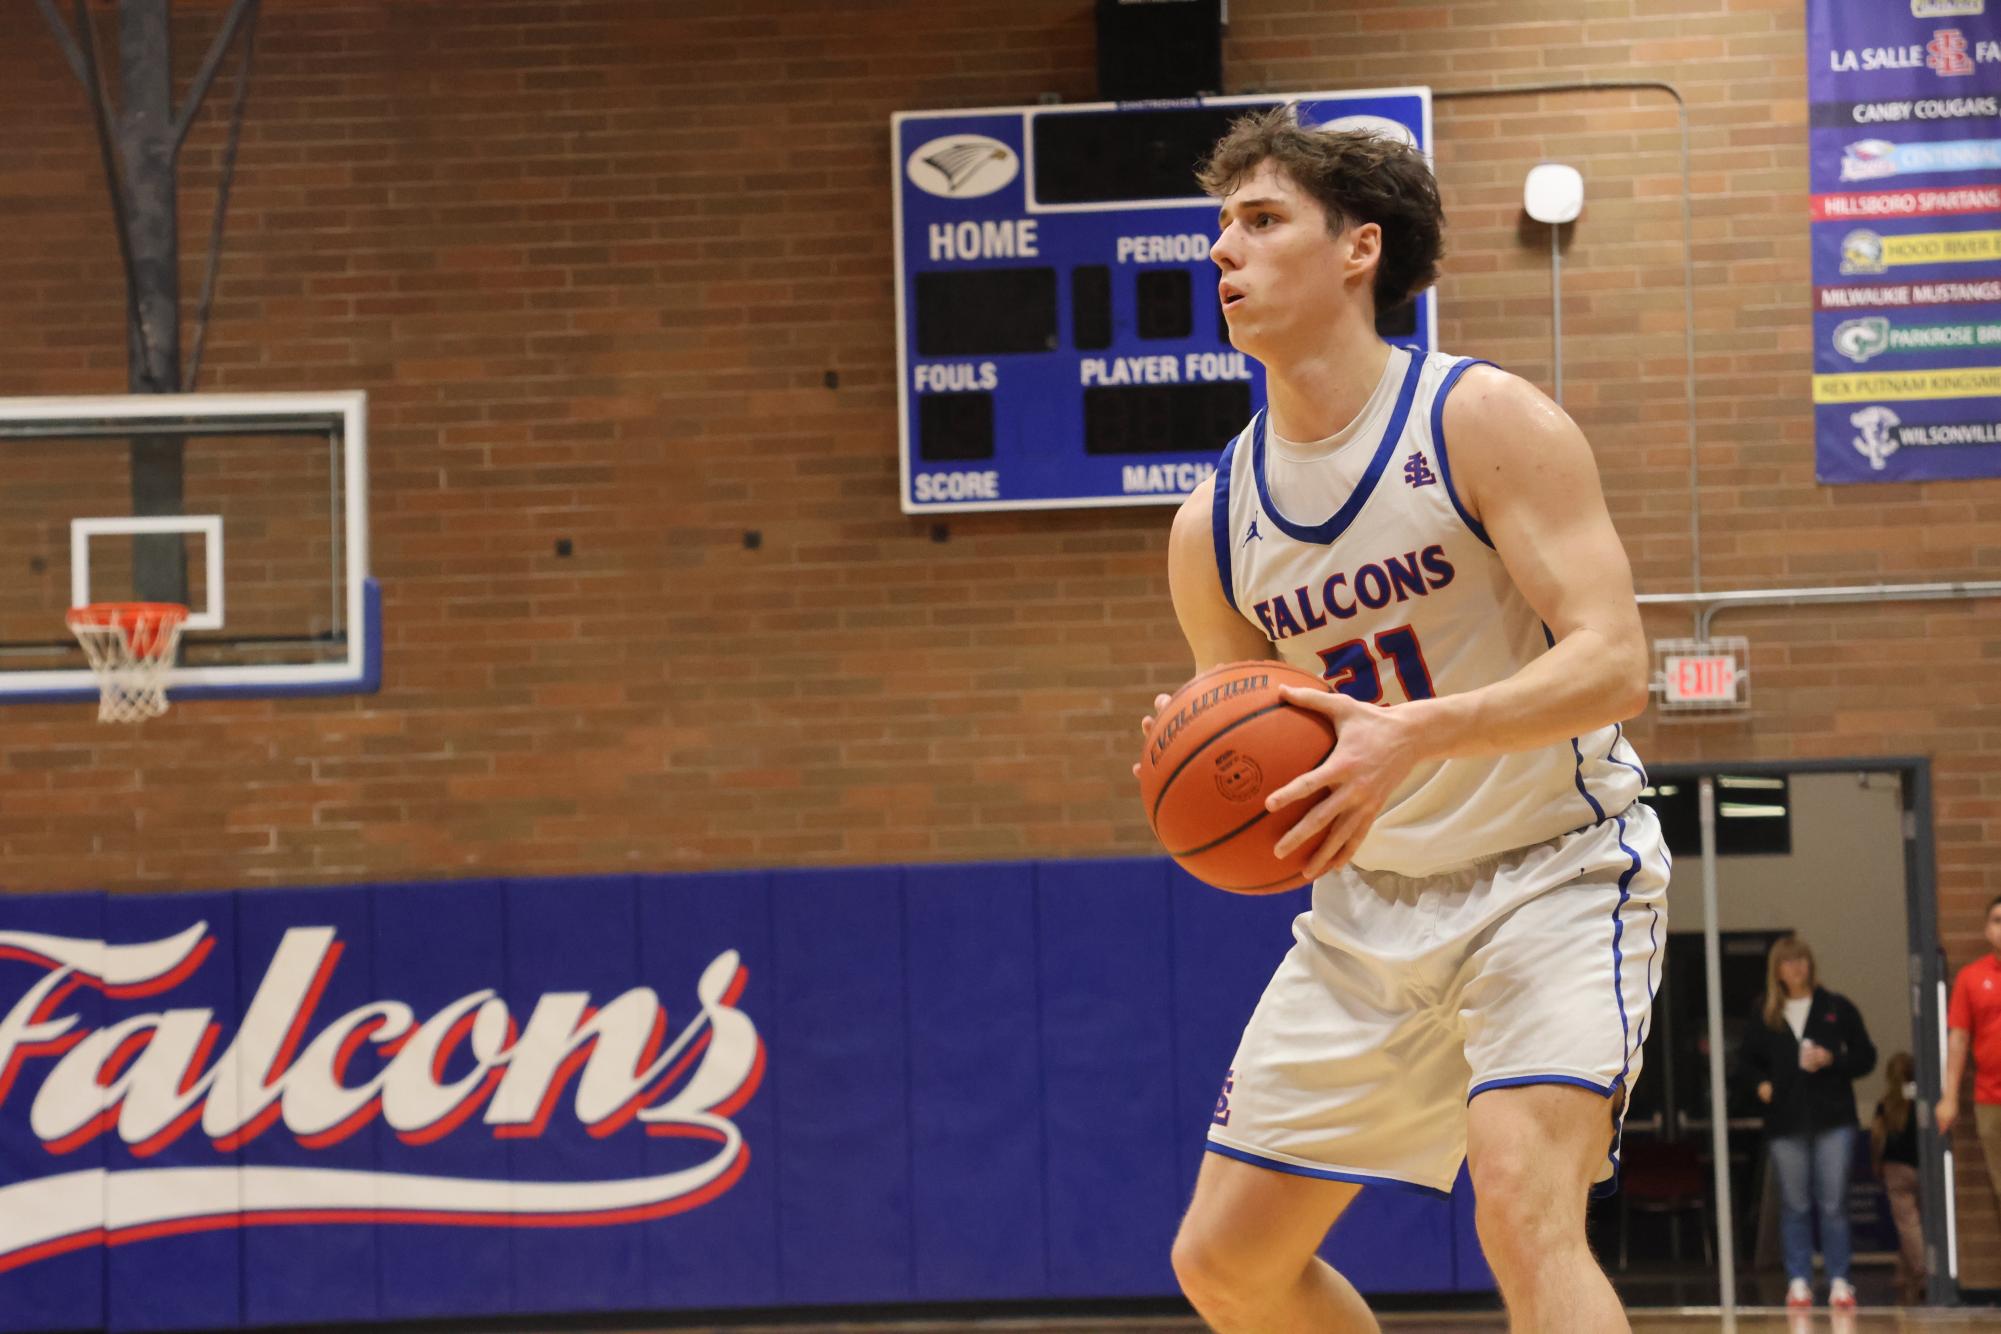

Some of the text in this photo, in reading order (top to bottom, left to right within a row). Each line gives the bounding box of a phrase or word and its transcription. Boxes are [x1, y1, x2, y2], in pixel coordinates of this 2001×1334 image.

[1830, 50, 1859, 71] LA
[1861, 45, 1924, 70] SALLE
[1852, 97, 1998, 123] CANBY COUGARS
[1824, 188, 2000, 216] HILLSBORO SPARTANS
[929, 219, 1039, 261] HOME
[1117, 234, 1210, 264] PERIOD
[1913, 281, 2001, 301] MUSTANGS
[1890, 326, 1974, 347] PARKROSE
[915, 362, 998, 392] FOULS
[1081, 351, 1253, 385] PLAYER FOUL
[915, 471, 999, 501] SCORE
[1122, 463, 1216, 493] MATCH
[1253, 545, 1455, 641] FALCONS
[1316, 624, 1437, 708] 21
[1679, 656, 1726, 698] EXIT
